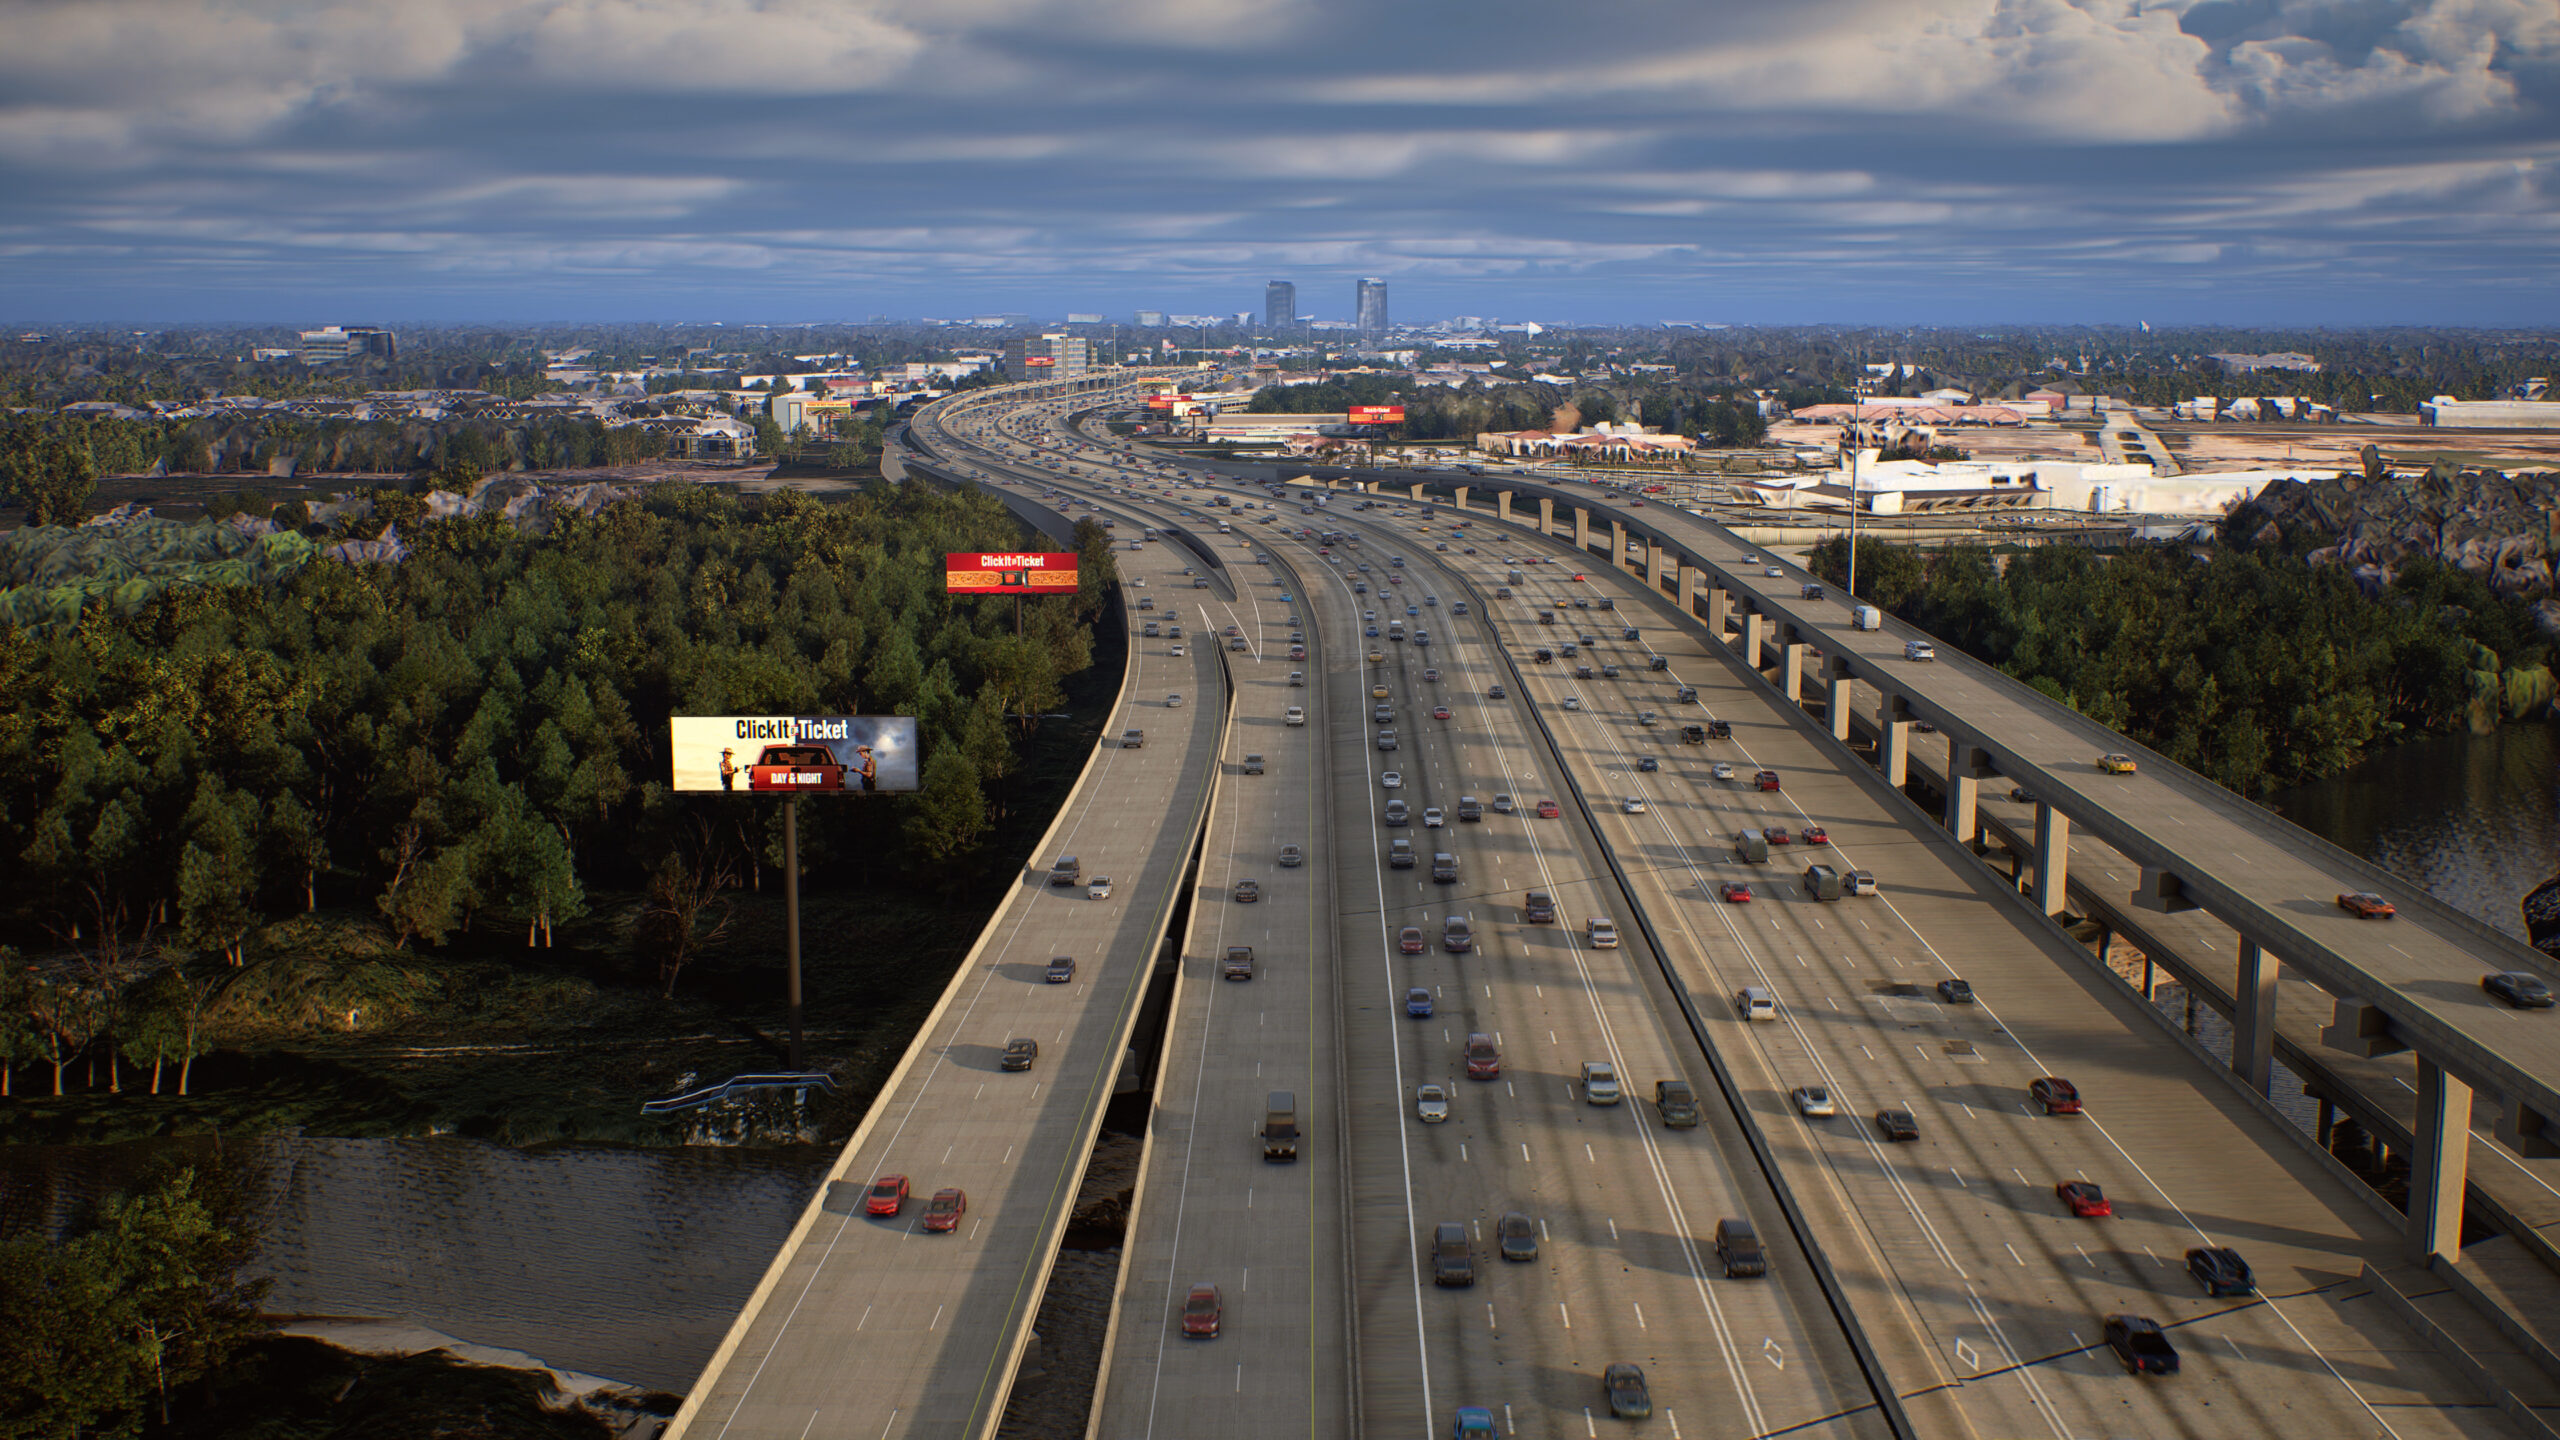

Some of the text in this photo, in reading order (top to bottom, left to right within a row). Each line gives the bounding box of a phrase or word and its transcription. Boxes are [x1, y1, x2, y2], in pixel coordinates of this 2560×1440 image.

[1016, 555, 1044, 567] Ticket
[798, 720, 848, 739] Ticket
[771, 772, 822, 784] DAY & NIGHT
